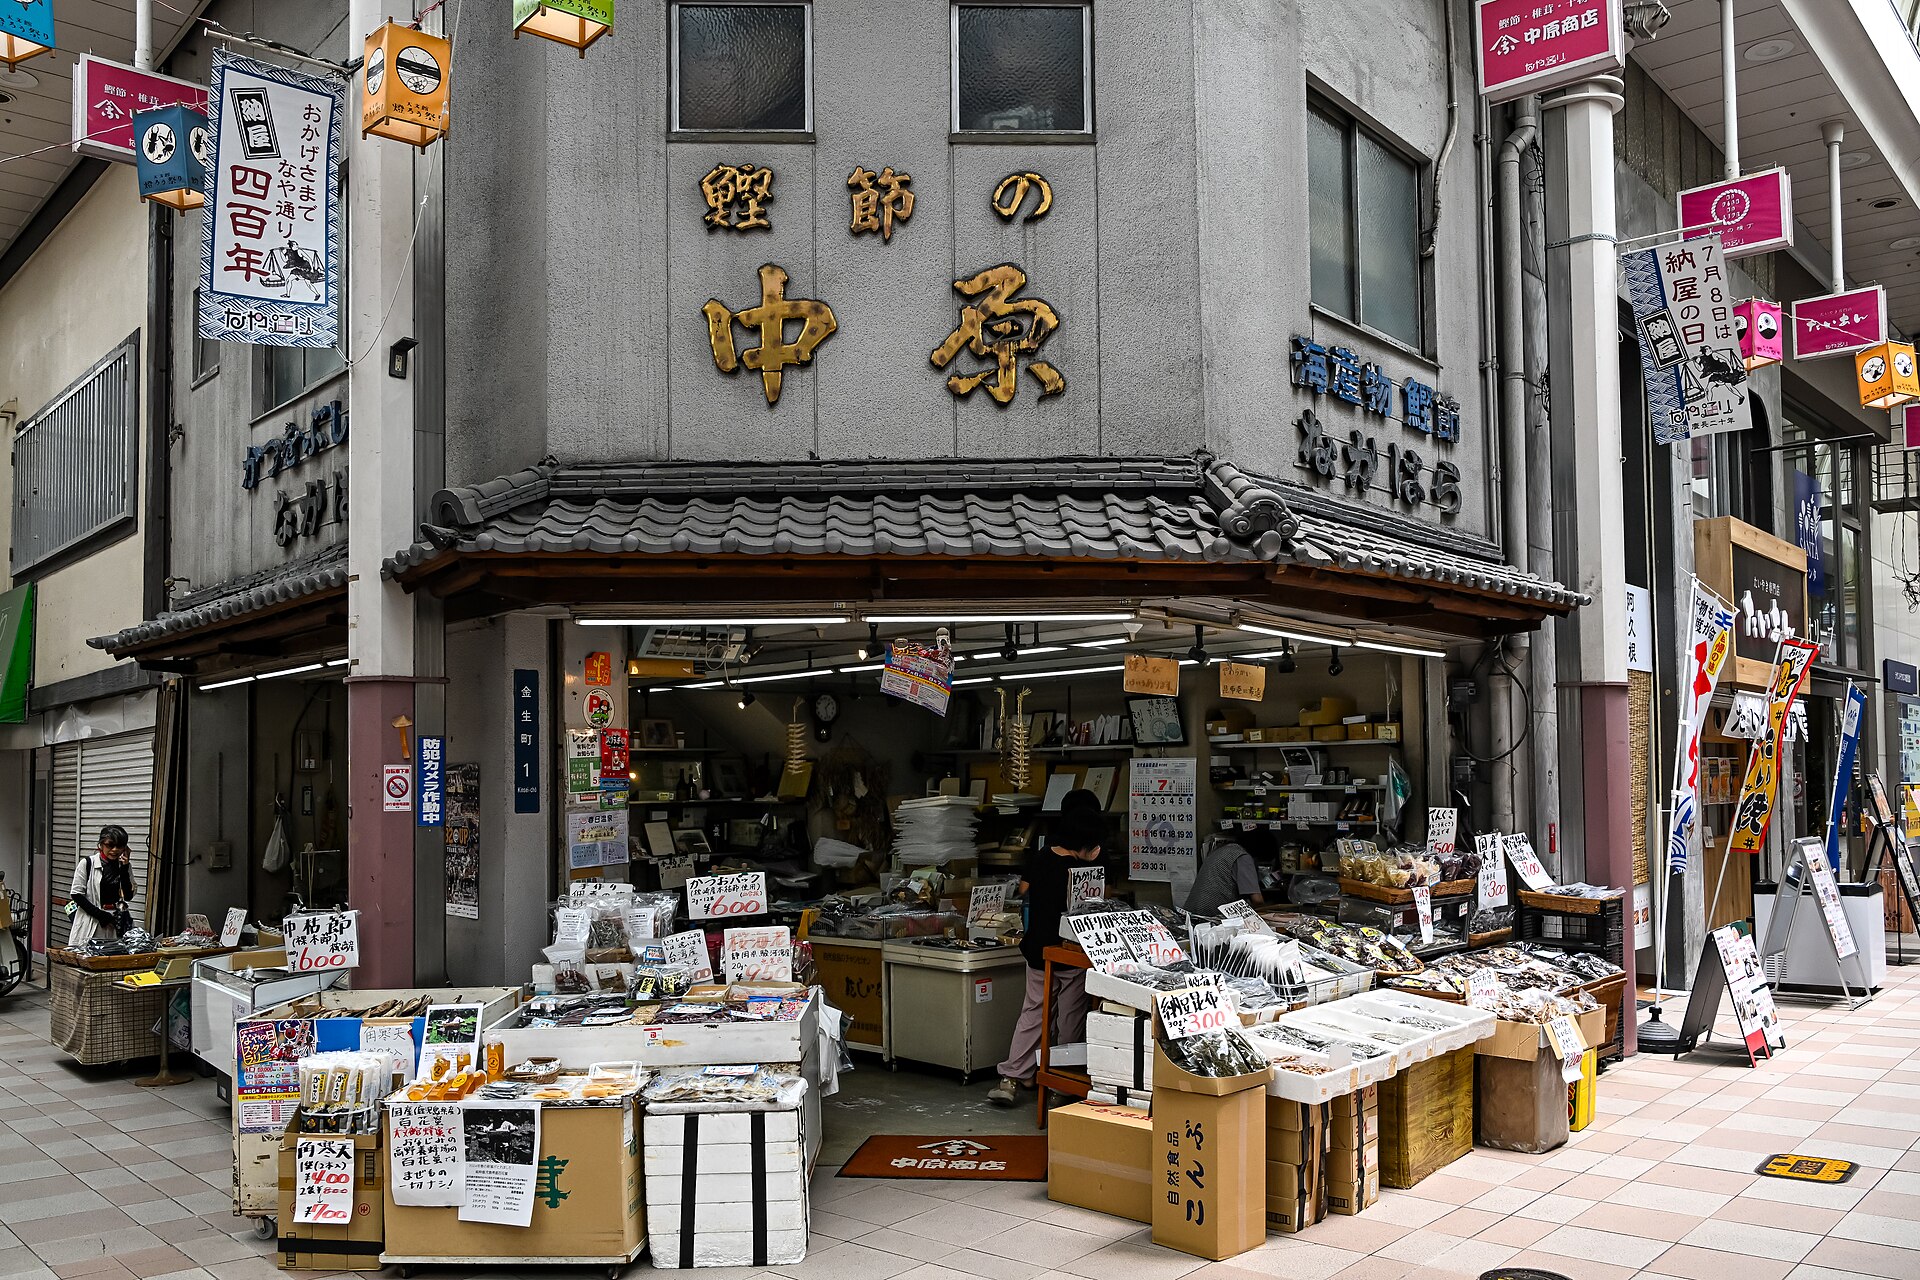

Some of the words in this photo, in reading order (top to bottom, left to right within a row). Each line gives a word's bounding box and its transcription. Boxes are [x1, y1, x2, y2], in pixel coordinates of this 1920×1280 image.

[1524, 9, 1599, 45] 中原商店
[239, 97, 272, 149] 納屋
[298, 103, 322, 223] おかげさまで
[276, 159, 297, 239] なや通り
[223, 164, 272, 283] 四百年
[1665, 248, 1705, 345] 納屋の日
[1701, 245, 1732, 340] 7月8日は
[223, 306, 314, 336] なや通り
[701, 262, 1067, 407] 中原
[1290, 335, 1392, 417] 海産物
[1669, 399, 1734, 425] なや通り
[1299, 408, 1462, 514] なかはら
[1626, 591, 1637, 663] 阿久根
[520, 685, 533, 746] 金生町
[422, 738, 440, 824] 防犯カメラ作動中
[523, 763, 530, 778] 1
[1157, 779, 1168, 791] 7
[1478, 835, 1497, 853] 国産
[689, 873, 760, 889] かつおパック
[283, 914, 353, 939] 中枯節
[1083, 929, 1118, 949] ごまめ
[290, 946, 346, 971] ¥600
[1160, 990, 1219, 1021] 納豆昆布
[241, 1030, 275, 1045] なやの日
[363, 1026, 406, 1043] 角寒天
[298, 1141, 352, 1160] 角寒天
[890, 1157, 1006, 1172] 中原商店
[304, 1169, 350, 1184] ¥400
[402, 1168, 447, 1181] まぜもの
[1166, 1130, 1180, 1206] 自然食品
[1184, 1118, 1205, 1226] こんぶ
